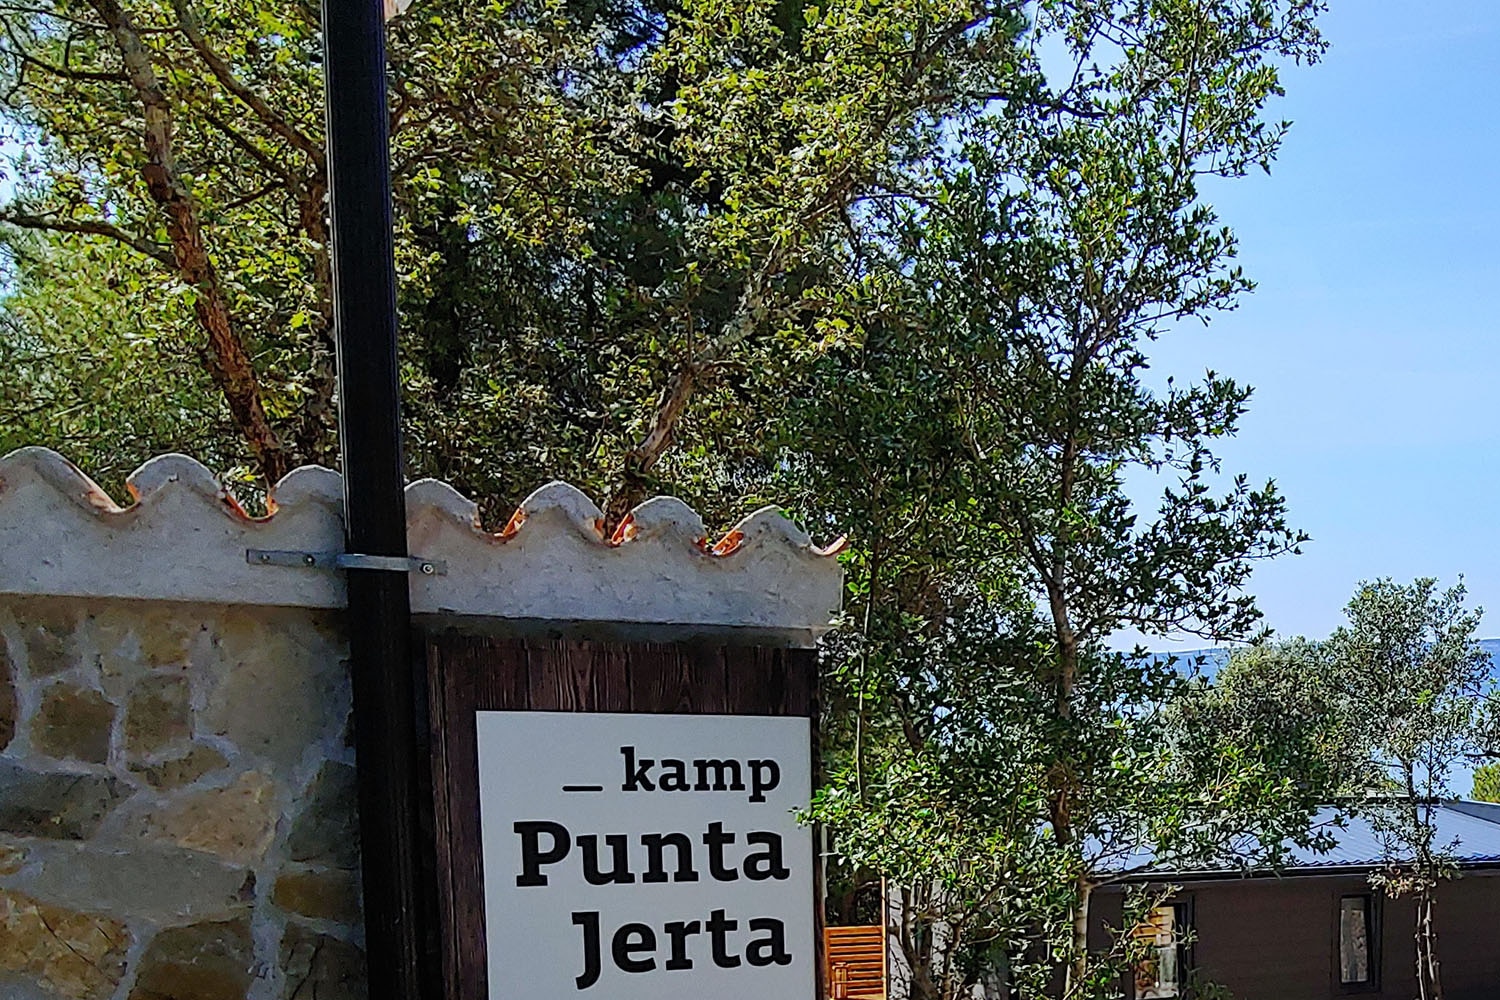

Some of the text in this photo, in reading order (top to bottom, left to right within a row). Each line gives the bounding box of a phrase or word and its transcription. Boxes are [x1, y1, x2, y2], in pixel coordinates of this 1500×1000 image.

[620, 746, 781, 803] kamp
[513, 821, 791, 887] Punta
[571, 909, 793, 991] Jerta
